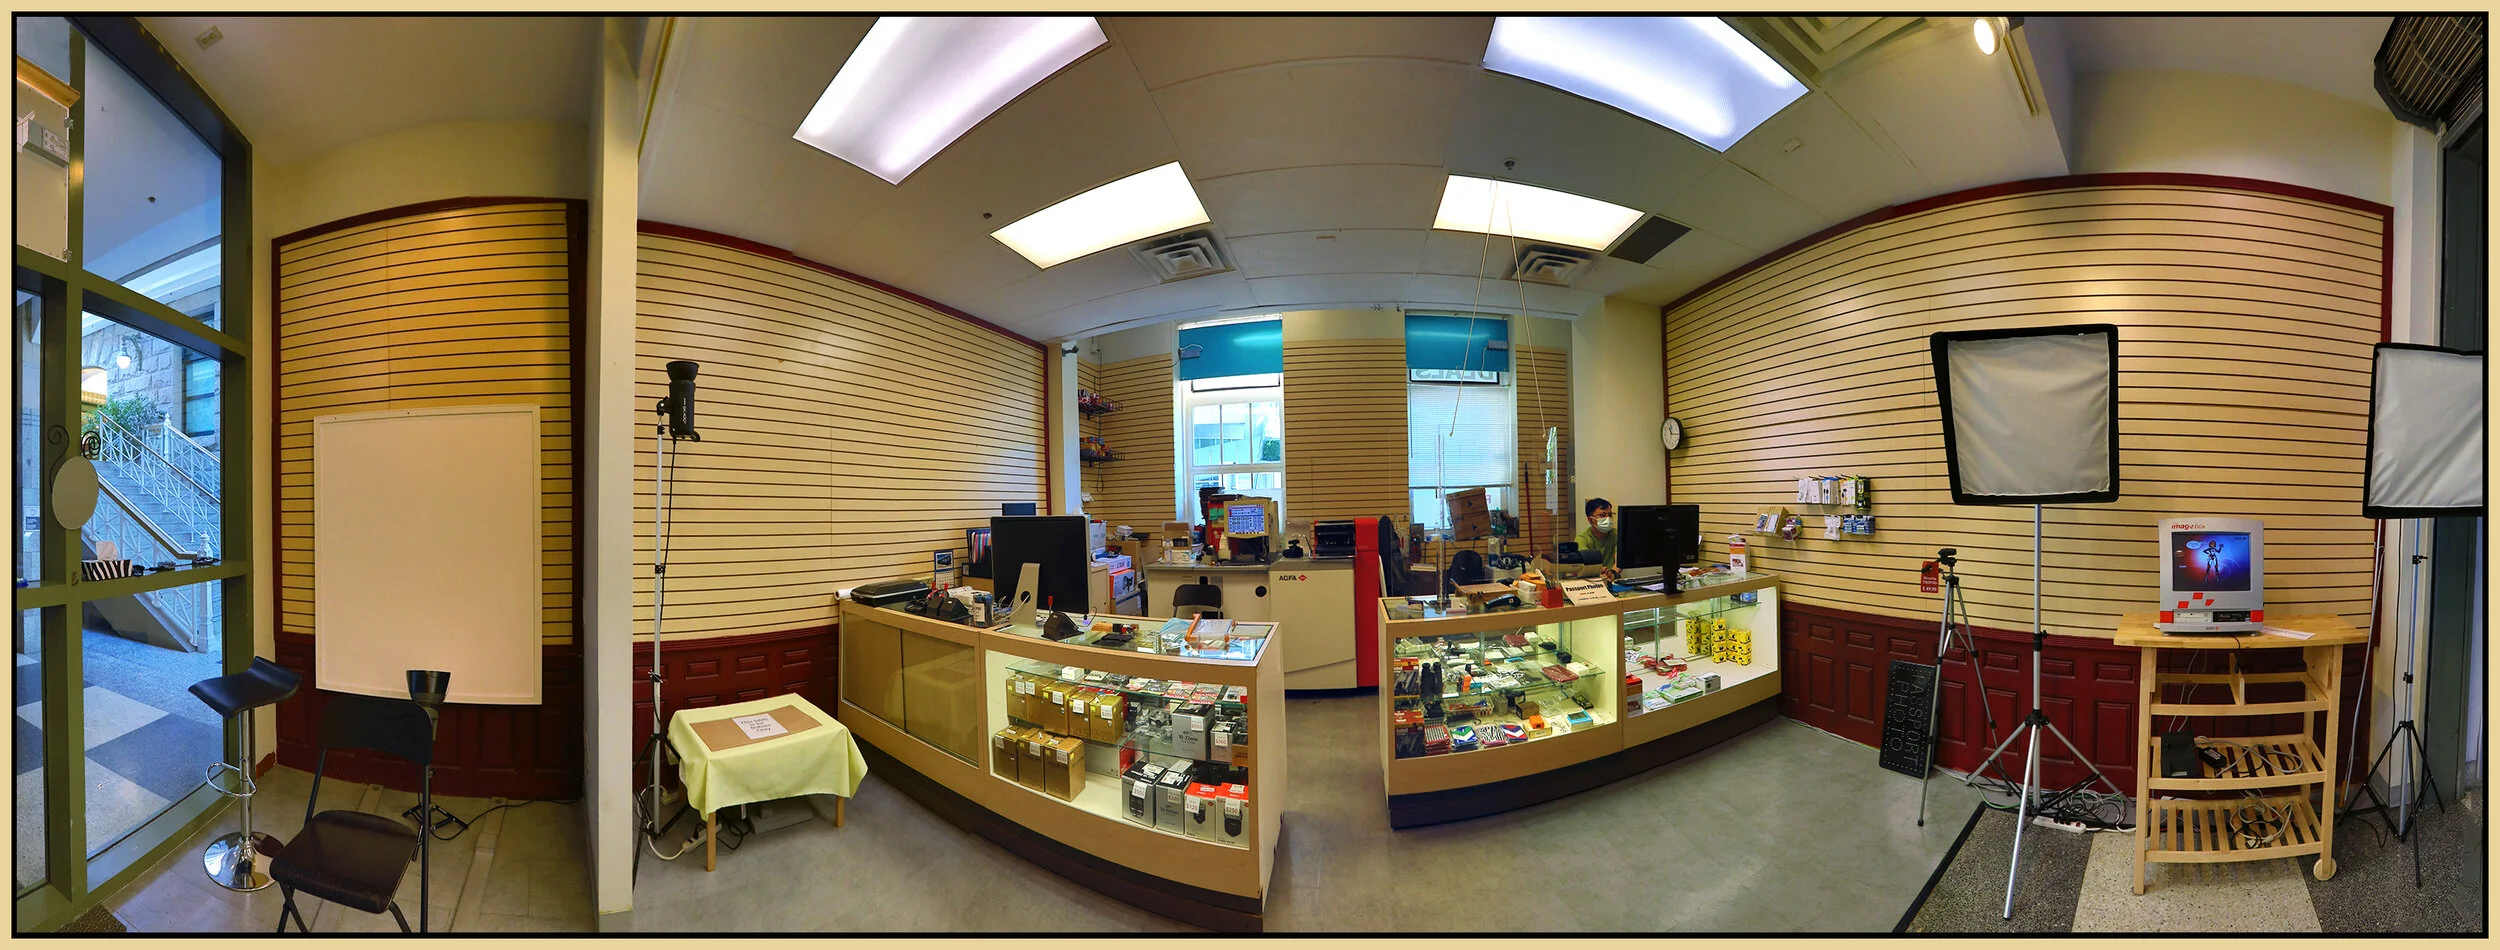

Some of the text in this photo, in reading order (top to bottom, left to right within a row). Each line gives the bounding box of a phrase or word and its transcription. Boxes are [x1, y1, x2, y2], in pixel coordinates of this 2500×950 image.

[1565, 584, 1588, 592] Passport
[1890, 680, 1910, 752] PHOTO
[1903, 674, 1925, 767] PASSPORT
